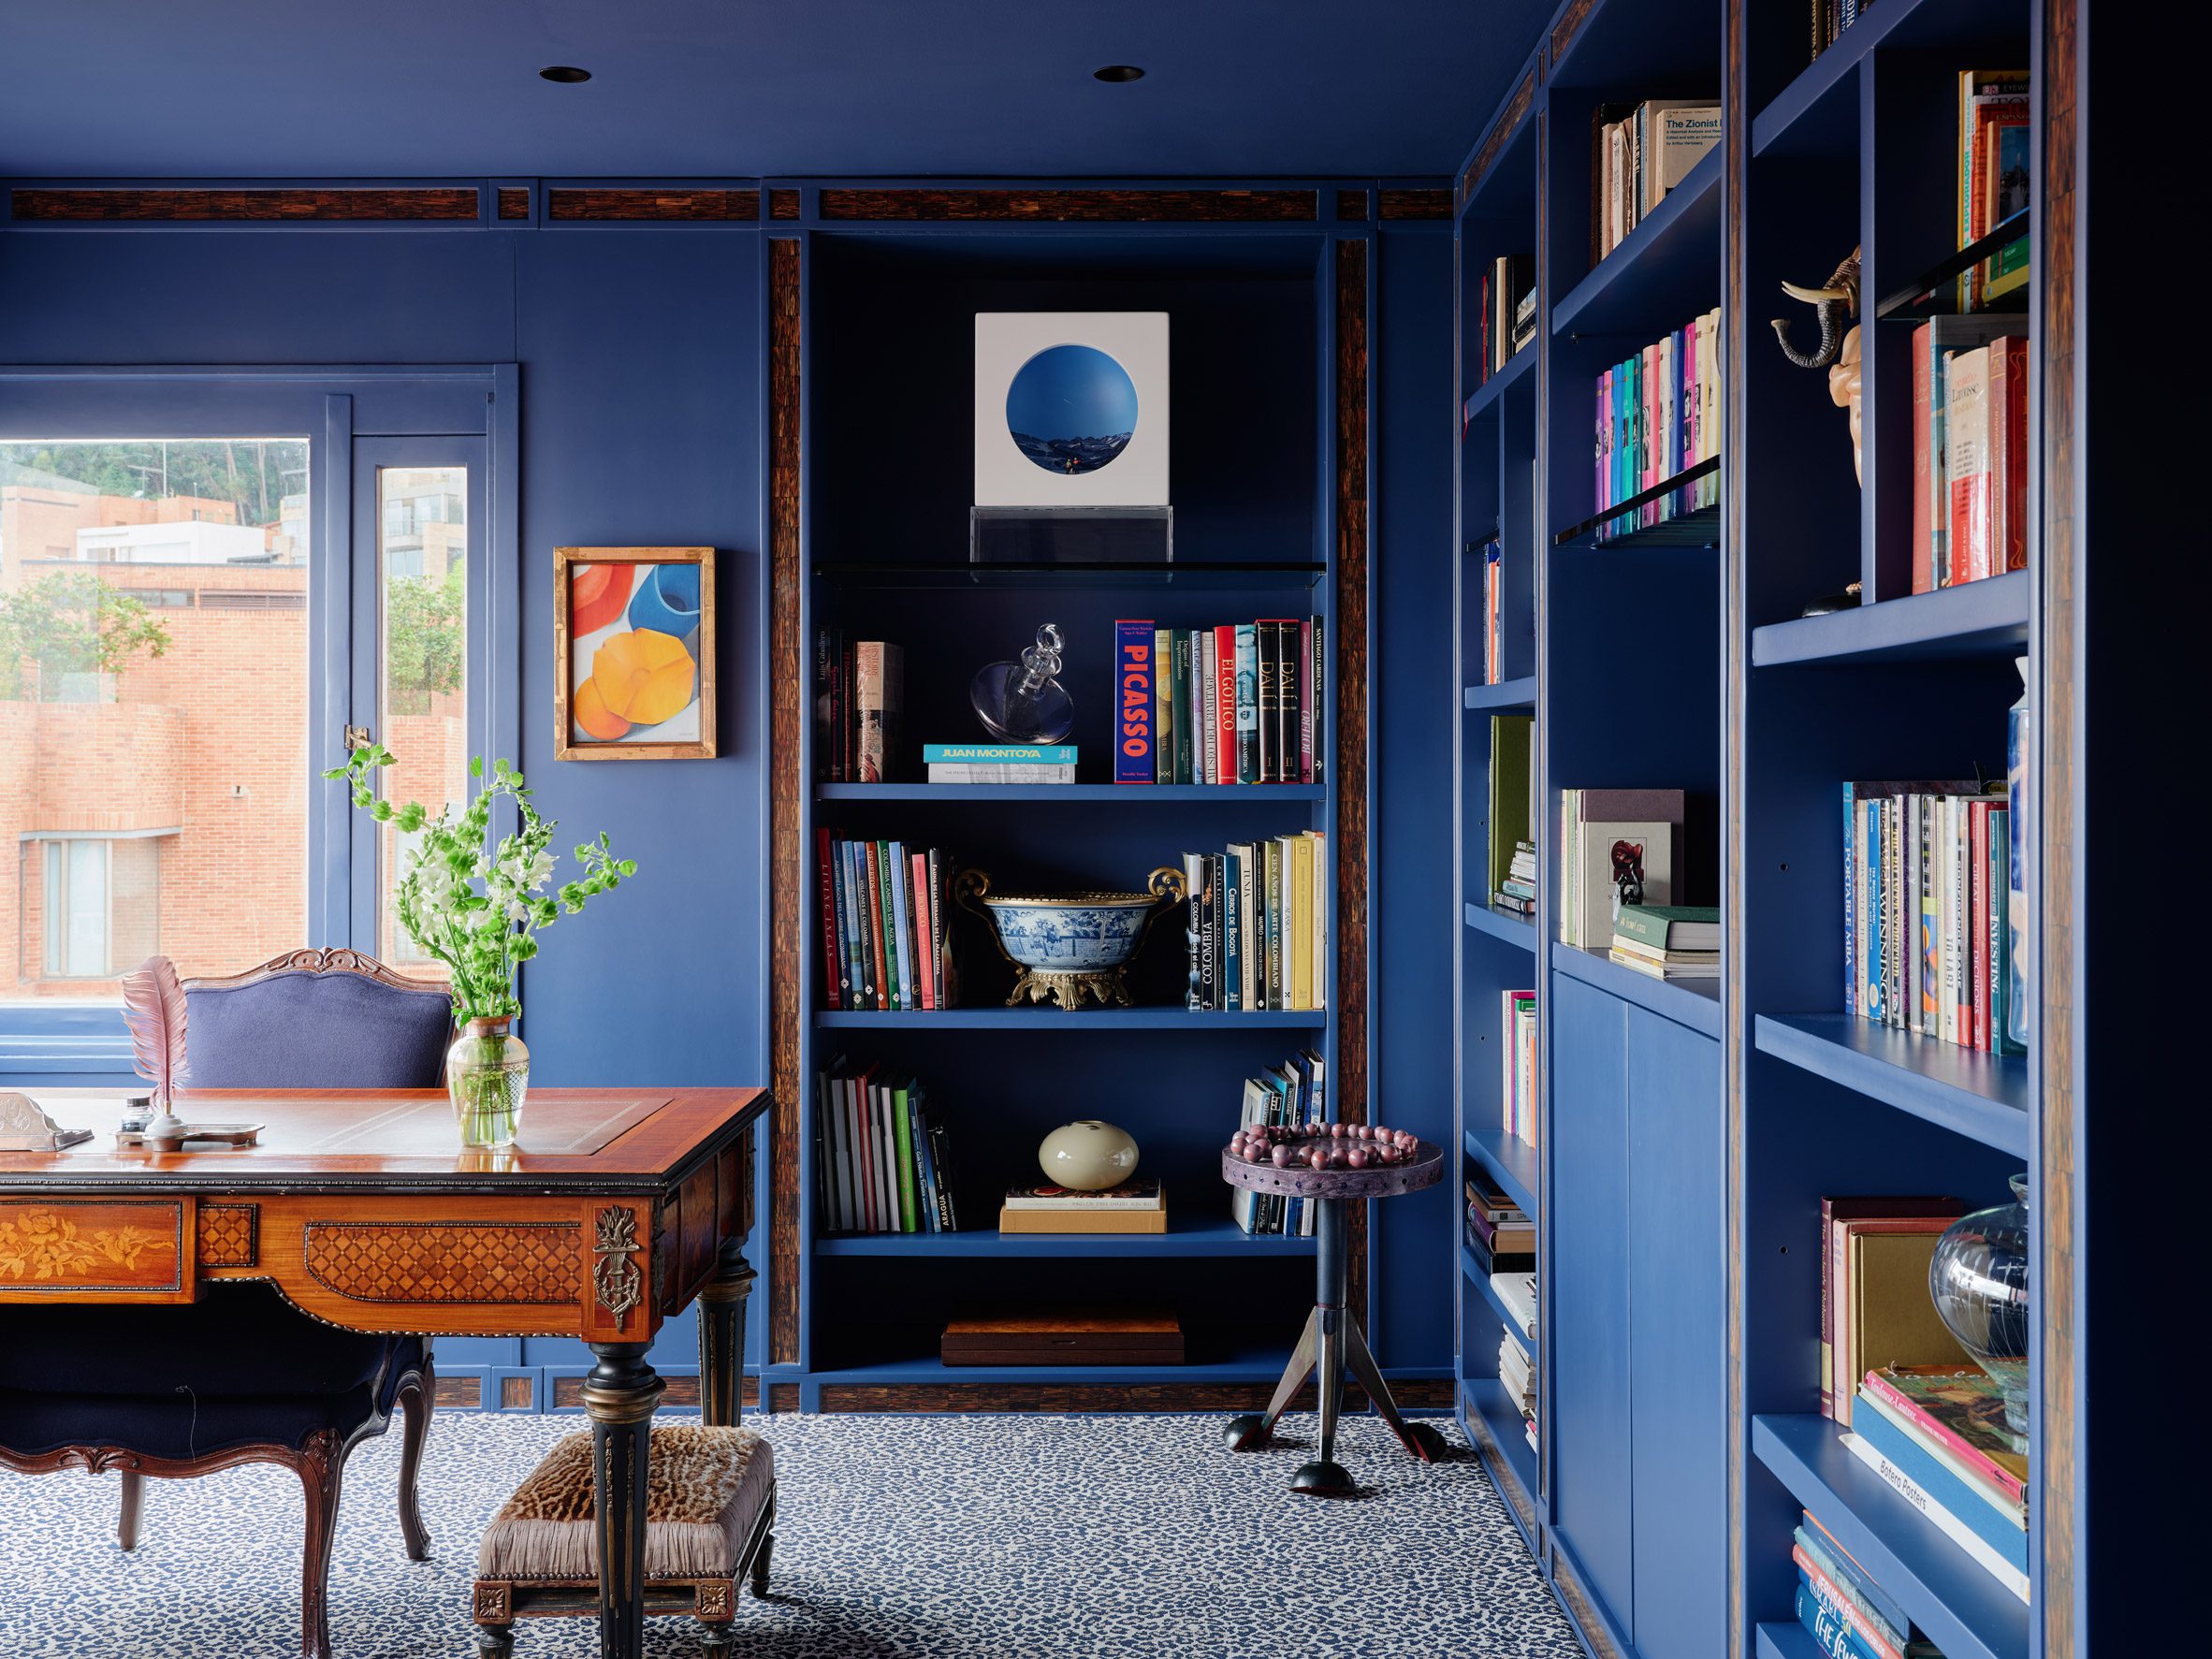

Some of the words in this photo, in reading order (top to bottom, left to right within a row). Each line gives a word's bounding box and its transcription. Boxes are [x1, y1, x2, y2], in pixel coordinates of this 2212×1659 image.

[1666, 120, 1683, 128] The
[1685, 119, 1718, 128] Zionist
[1222, 659, 1233, 675] EL
[1260, 662, 1278, 700] DALÍ
[1281, 662, 1298, 700] DALÍ
[1123, 645, 1149, 757] PICASSO
[1206, 674, 1215, 721] ERMITAGE
[1222, 677, 1235, 731] GÓTICO
[942, 749, 975, 758] JUAN
[977, 749, 1041, 758] MONTOYA
[1206, 724, 1215, 744] DEL
[1301, 710, 1311, 755] BOTERO
[1206, 747, 1215, 780] MUSEO
[867, 851, 877, 889] DESIERTOS
[1880, 841, 1890, 887] Welch
[822, 865, 831, 910] LIVING
[1229, 888, 1238, 914] CERROS
[1272, 875, 1280, 897] AÑOS
[1272, 898, 1279, 910] DE
[825, 917, 834, 958] INCAS
[1229, 916, 1235, 925] DE
[1203, 923, 1213, 984] COLOMBIA
[1229, 927, 1239, 957] BOGOTÁ
[1272, 935, 1280, 988] COLOMBIANO
[1880, 892, 1888, 999] WINNING
[1990, 915, 2000, 994] INVESTING
[939, 1194, 950, 1227] ARAGUA
[1870, 1377, 1917, 1422] Toulouse-Lautrec
[1880, 1460, 1901, 1488] Botero
[1902, 1478, 1927, 1510] Posters
[1810, 1579, 1840, 1625] ISRAEL
[1817, 1575, 1855, 1624] JERUSALÉN
[1815, 1606, 1834, 1649] THE
